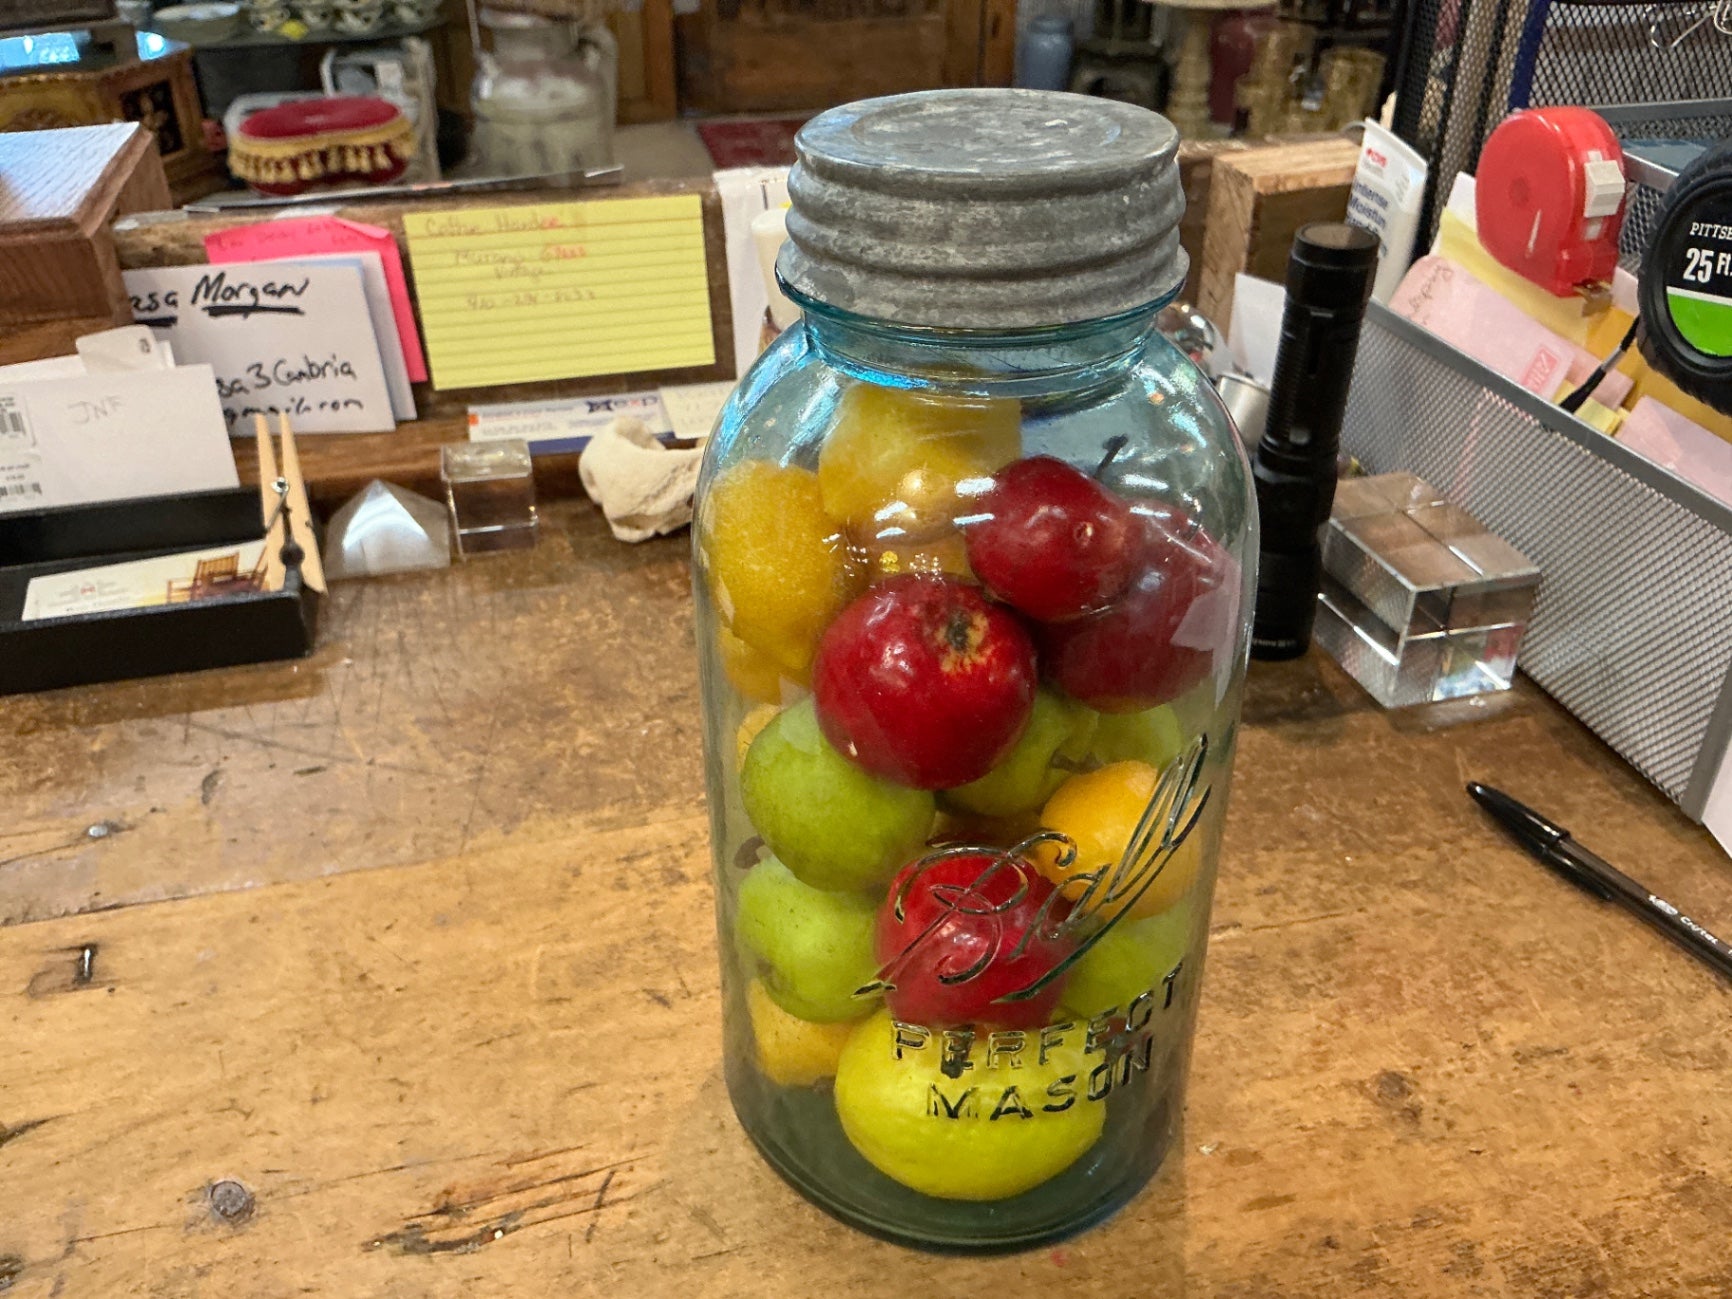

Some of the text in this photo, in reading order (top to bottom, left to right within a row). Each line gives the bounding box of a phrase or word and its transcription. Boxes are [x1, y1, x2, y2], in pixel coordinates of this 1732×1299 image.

[191, 271, 310, 316] Morgan
[1683, 247, 1714, 283] 25
[891, 962, 1184, 1074] PERFECT
[927, 1032, 1154, 1121] MASON
